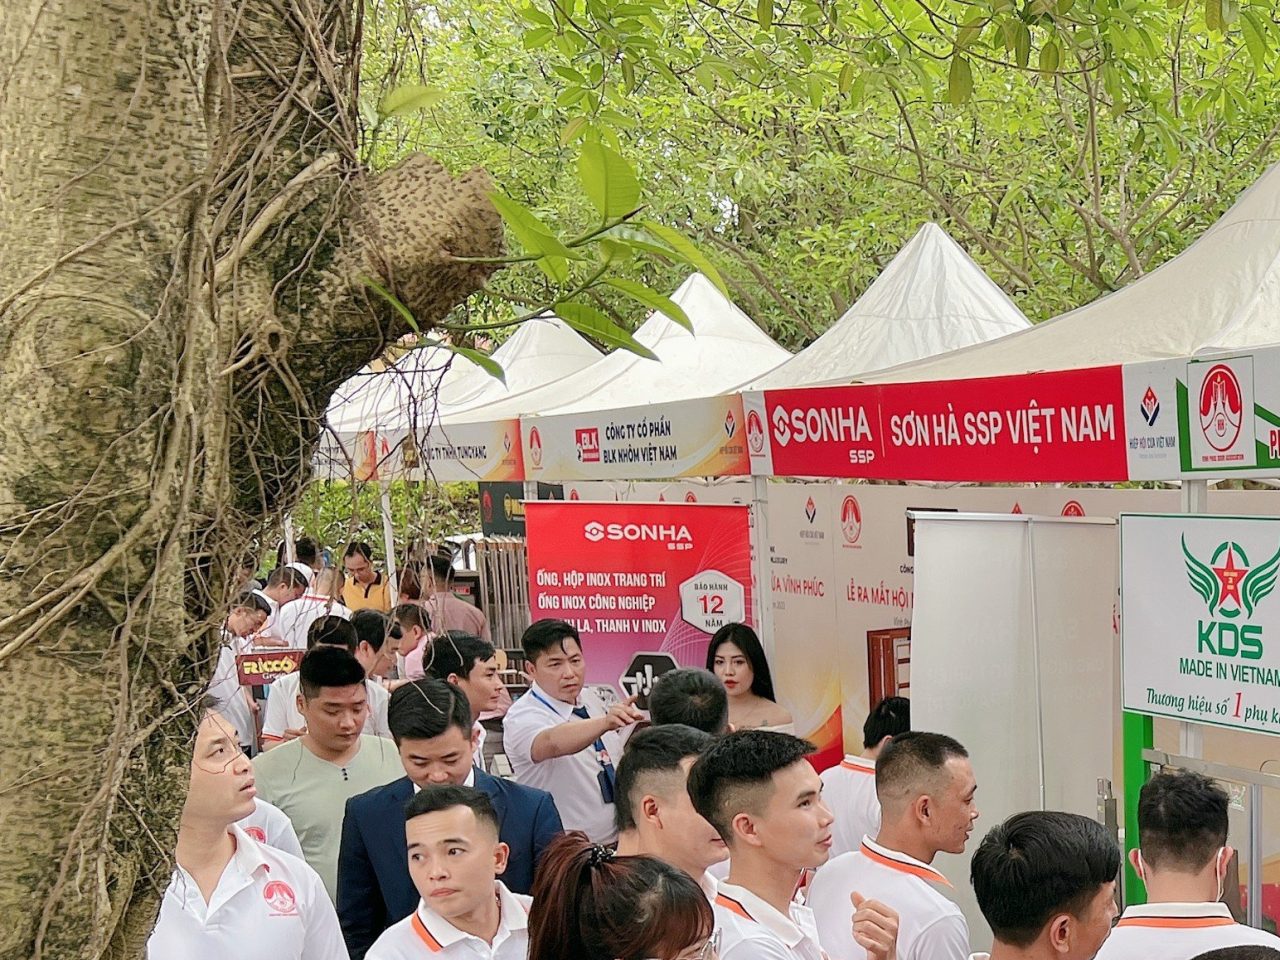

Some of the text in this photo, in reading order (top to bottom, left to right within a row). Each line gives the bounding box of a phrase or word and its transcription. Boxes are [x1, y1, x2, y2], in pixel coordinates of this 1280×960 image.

[605, 421, 636, 440] CÔNG TY
[792, 405, 874, 443] SONHA
[891, 399, 1116, 455] SƠN HÀ SSP VIỆT NAM
[603, 449, 617, 463] BLK
[640, 442, 658, 466] VIỆT
[659, 444, 678, 462] NAM
[849, 449, 875, 464] SSP
[607, 524, 693, 542] SONHA
[667, 543, 693, 551] SSP
[563, 570, 584, 590] HỘP
[587, 572, 611, 587] INOX
[613, 572, 648, 588] TRANG
[650, 570, 666, 588] TRÍ
[803, 576, 825, 597] PHÚC
[538, 591, 656, 613] ỐNG INOX CÔNG NGHIỆP
[698, 595, 724, 614] 12
[858, 586, 869, 603] RA
[892, 586, 908, 612] HỘI
[595, 619, 631, 633] THANH
[632, 619, 640, 633] V
[642, 619, 666, 633] INOX
[1197, 620, 1264, 660] KDS
[1179, 657, 1213, 678] MADE
[1216, 661, 1227, 680] IN
[1146, 687, 1185, 713] Thương
[1188, 694, 1212, 716] hiệu
[1215, 696, 1230, 716] số
[1232, 692, 1243, 718] 1
[1244, 704, 1268, 727] phụ
